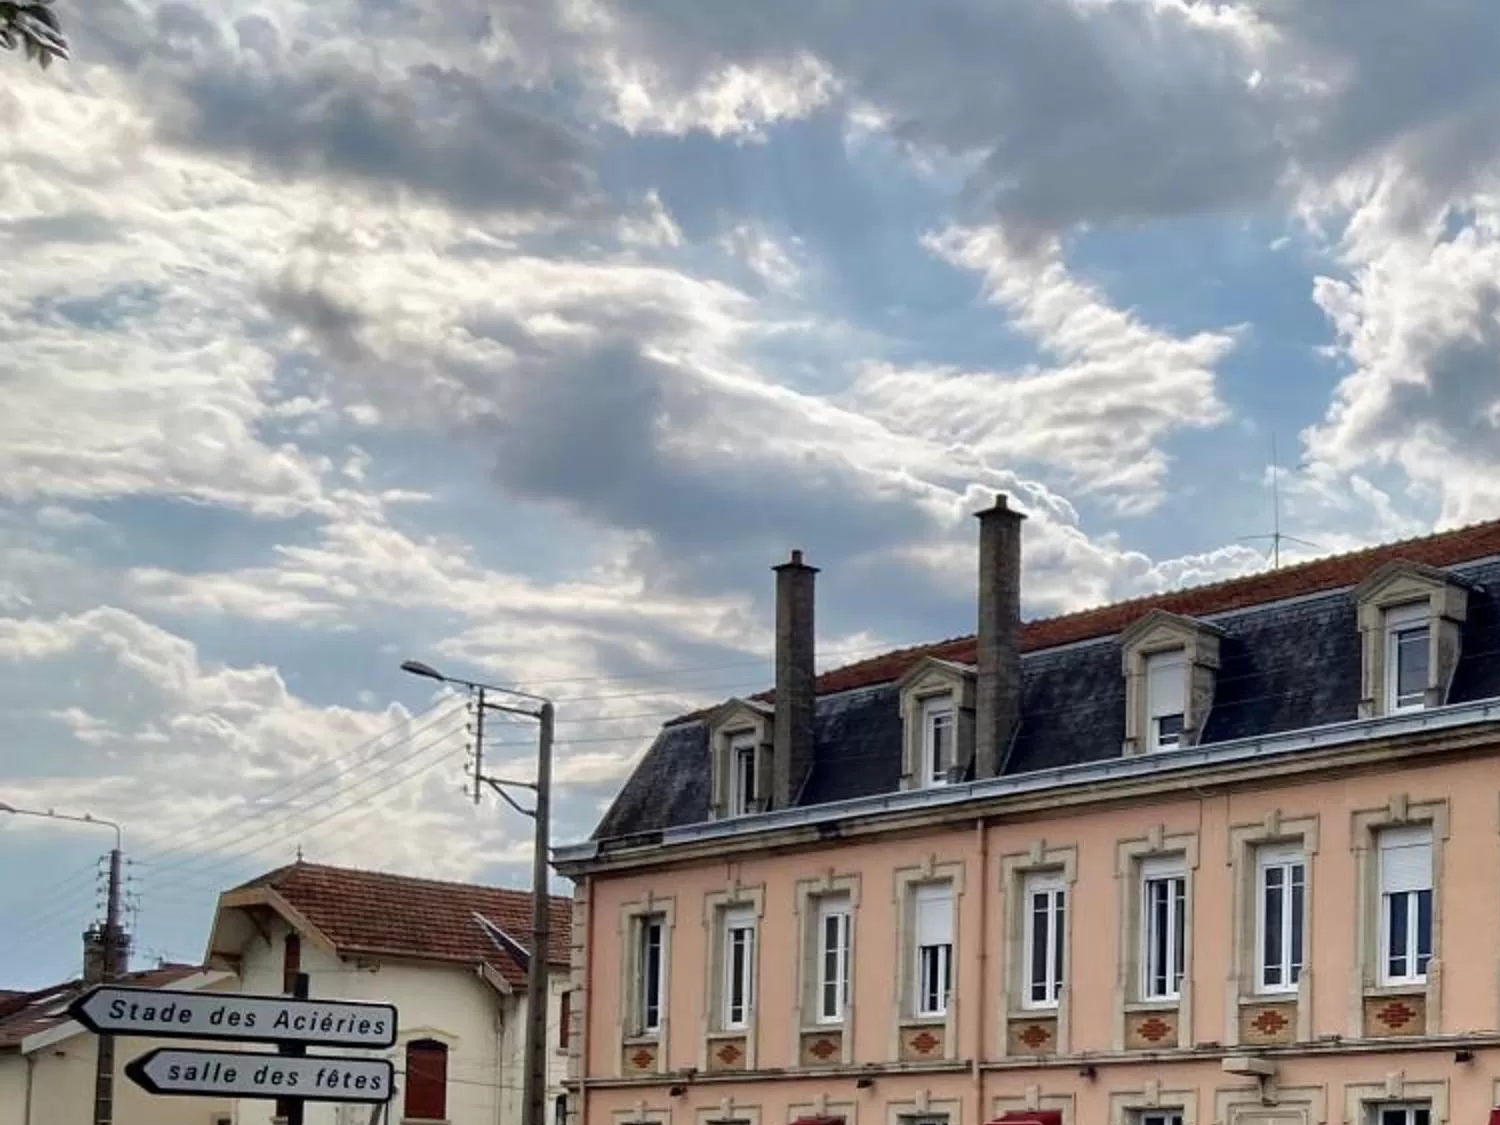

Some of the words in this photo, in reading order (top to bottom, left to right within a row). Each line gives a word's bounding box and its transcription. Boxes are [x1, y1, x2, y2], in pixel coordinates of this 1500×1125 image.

[108, 999, 193, 1023] Stade
[209, 1006, 256, 1027] des
[272, 1009, 386, 1035] Aciéries
[168, 1062, 237, 1083] salle
[253, 1064, 298, 1086] des
[315, 1068, 382, 1090] fêtes
